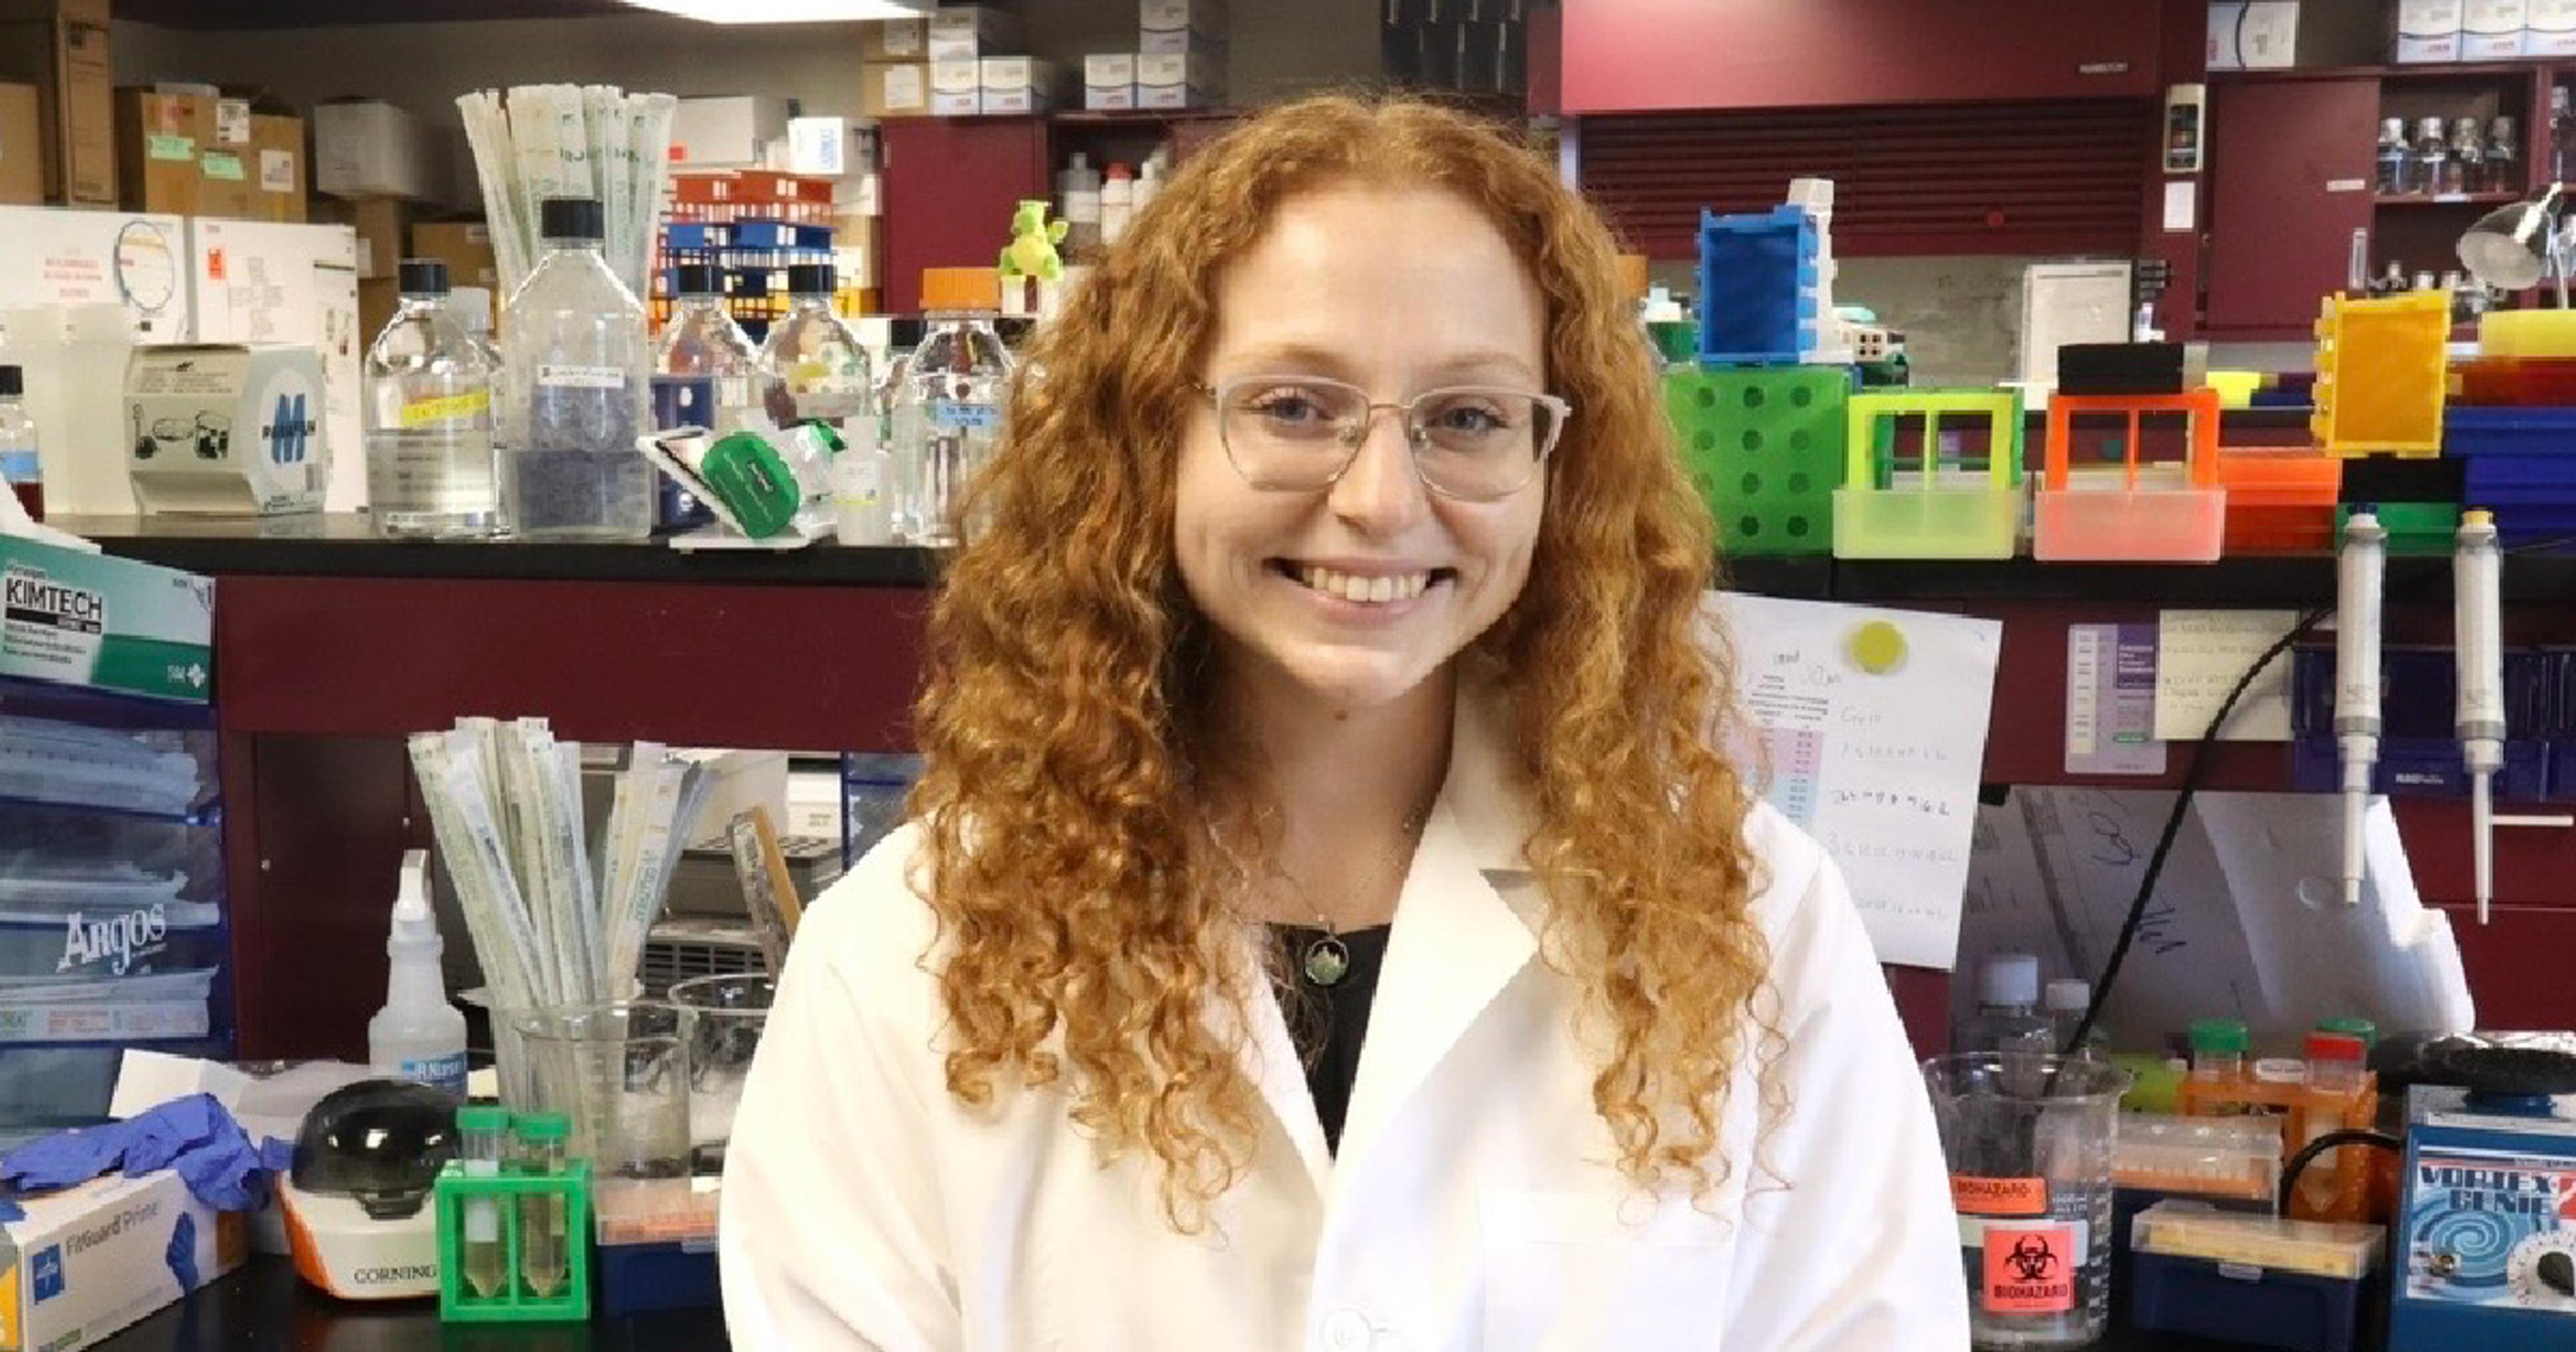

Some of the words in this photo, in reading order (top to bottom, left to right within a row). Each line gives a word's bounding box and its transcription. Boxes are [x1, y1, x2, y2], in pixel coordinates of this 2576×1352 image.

[6, 577, 101, 619] KIMTECH
[2421, 1166, 2553, 1194] VORTEX
[2450, 1189, 2557, 1214] GENIE
[354, 1265, 437, 1284] CORNING
[1994, 1284, 2068, 1299] BIOHAZARD
